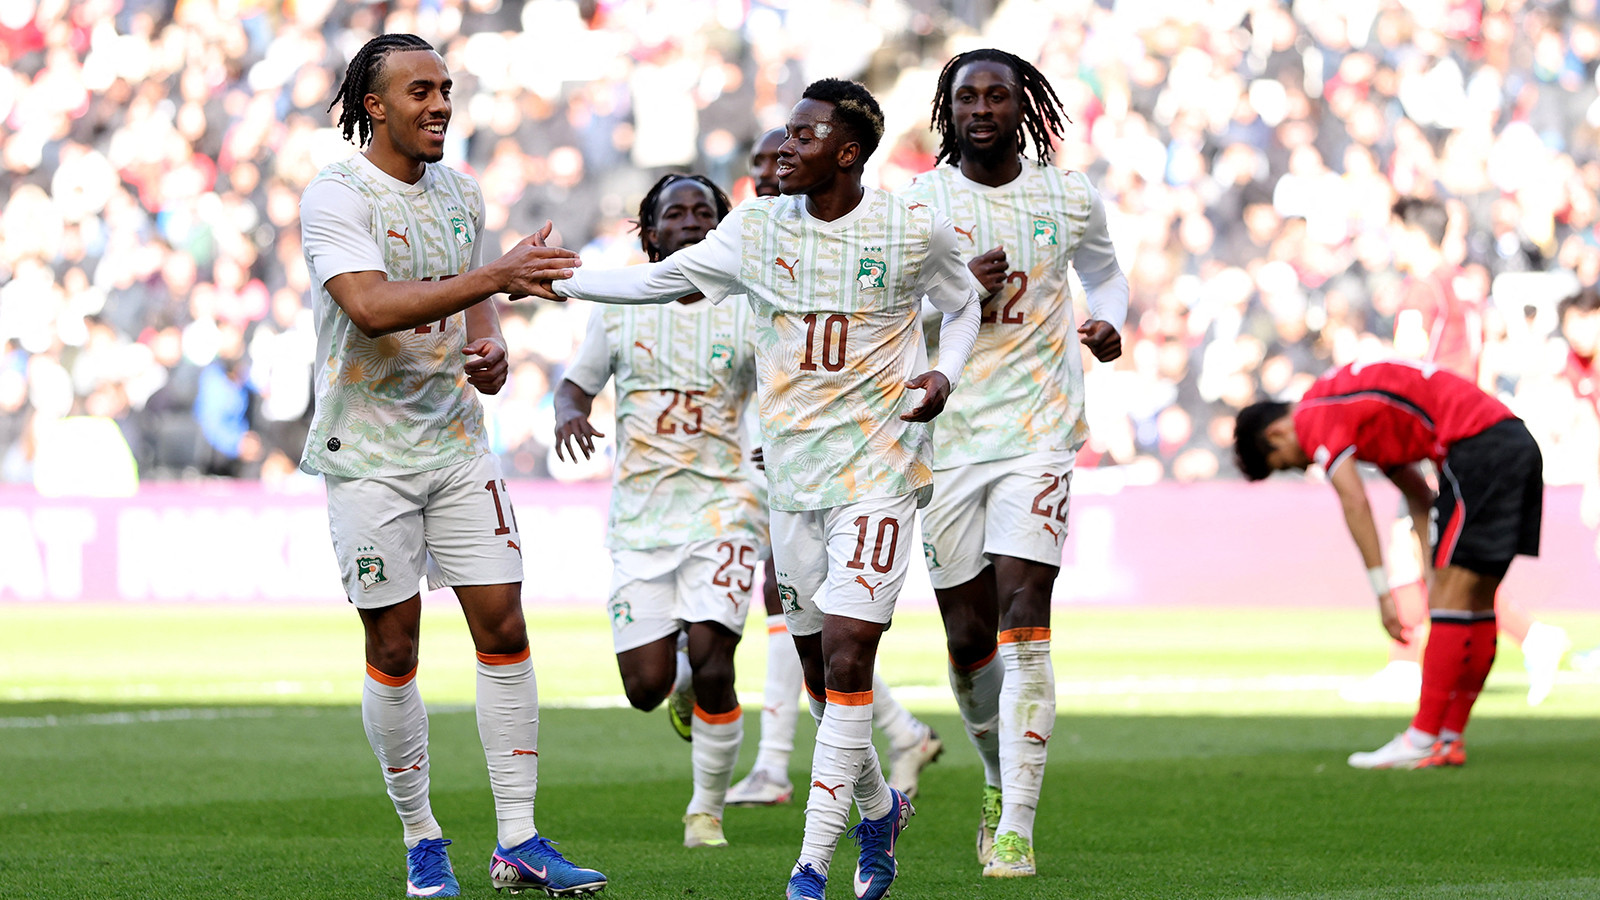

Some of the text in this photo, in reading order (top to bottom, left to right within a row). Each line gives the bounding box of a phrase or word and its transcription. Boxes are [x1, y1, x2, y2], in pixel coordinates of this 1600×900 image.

[800, 313, 849, 372] 10
[656, 389, 706, 435] 25
[1031, 472, 1070, 524] 22
[712, 541, 754, 592] 25
[846, 515, 900, 574] 10
